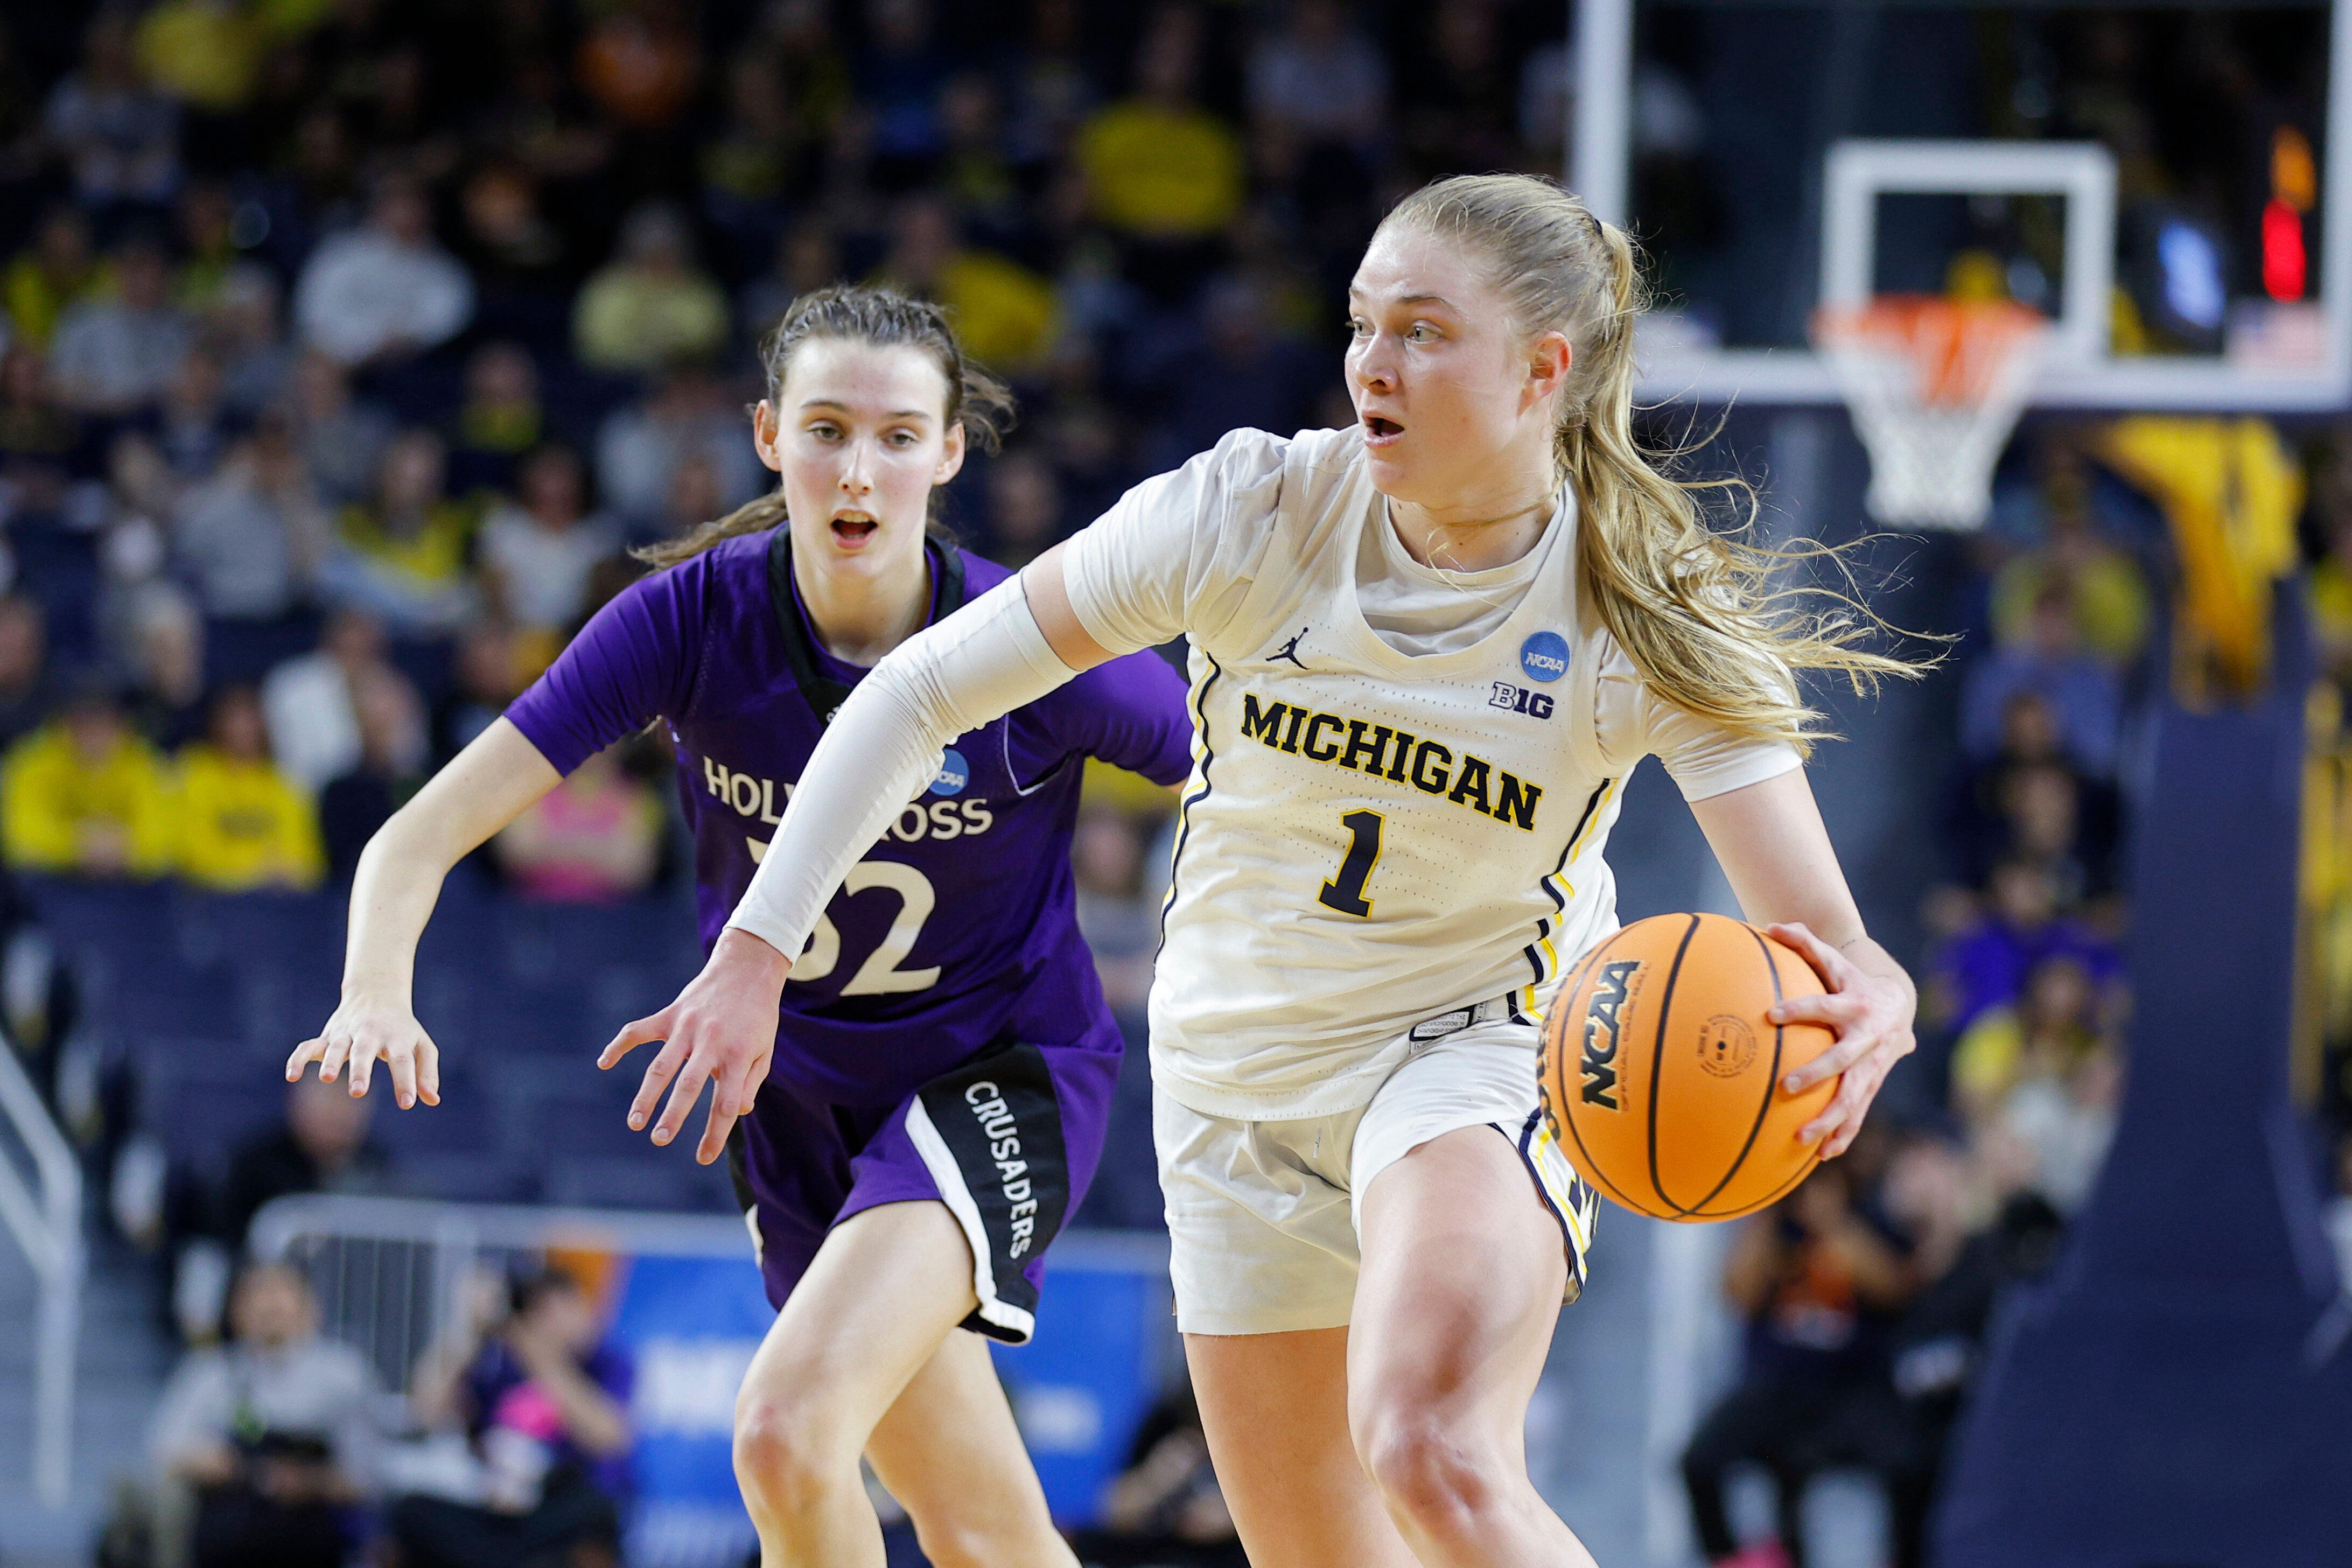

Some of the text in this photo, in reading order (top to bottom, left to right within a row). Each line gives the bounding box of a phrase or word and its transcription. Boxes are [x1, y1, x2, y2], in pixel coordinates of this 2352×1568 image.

[1524, 652, 1565, 673] NCAA
[703, 755, 995, 842] HOL OSS
[936, 771, 964, 789] CAA
[1241, 692, 1544, 833] MICHIGAN
[1318, 808, 1386, 918] 1
[1579, 960, 1643, 1112] NCAA
[964, 1081, 1039, 1259] CRUSADERS
